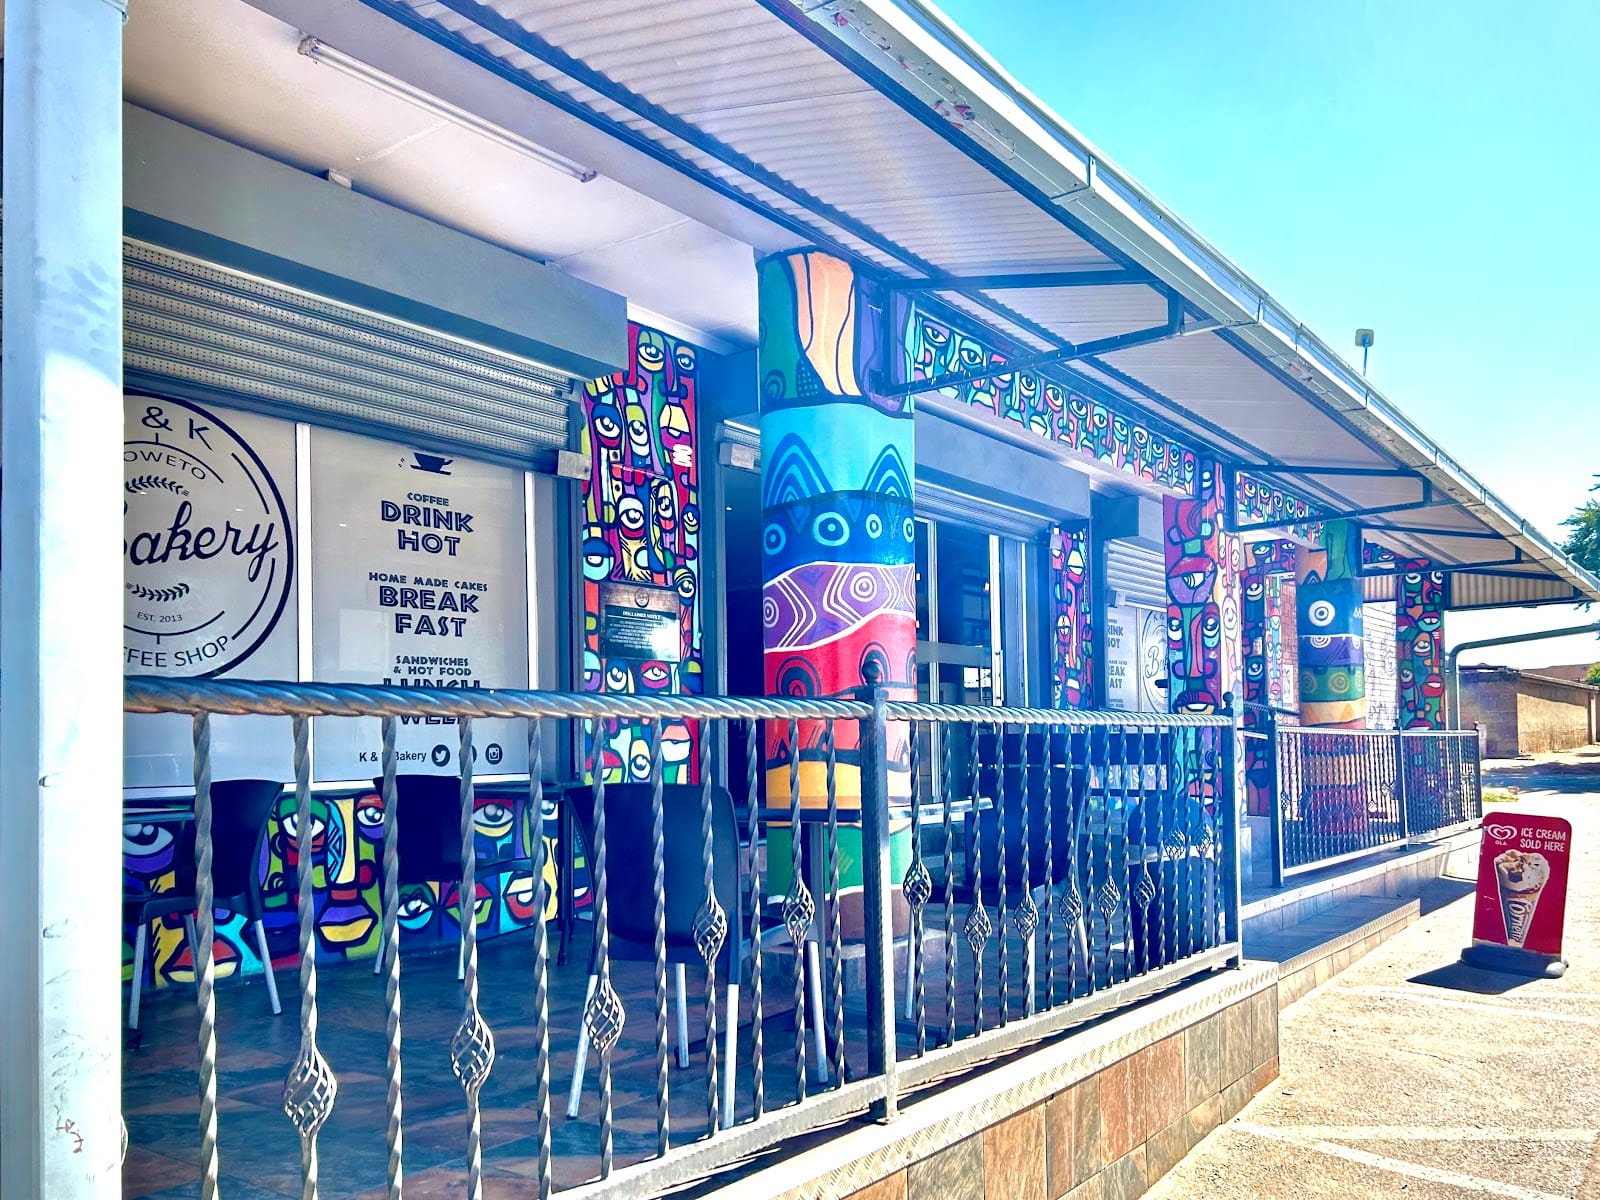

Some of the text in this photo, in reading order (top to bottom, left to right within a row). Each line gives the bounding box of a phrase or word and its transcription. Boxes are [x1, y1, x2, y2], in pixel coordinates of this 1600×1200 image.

[142, 406, 213, 451] & K
[124, 450, 206, 480] OWETO
[407, 492, 449, 506] COFFEE
[381, 500, 474, 533] DRINK
[124, 500, 279, 582] akery
[398, 529, 460, 556] HOT
[369, 572, 488, 592] HOME MADE CAKES
[380, 586, 479, 613] BREAK
[137, 612, 183, 622] EST. 2013
[395, 613, 467, 637] FAST
[174, 635, 228, 667] SHOP
[396, 656, 469, 667] SANDWICHES
[393, 666, 472, 676] & HOT FOOD
[359, 752, 367, 762] K
[370, 752, 378, 762] &
[1521, 827, 1566, 841] ICE CREAM
[1520, 839, 1565, 852] SOLD HERE
